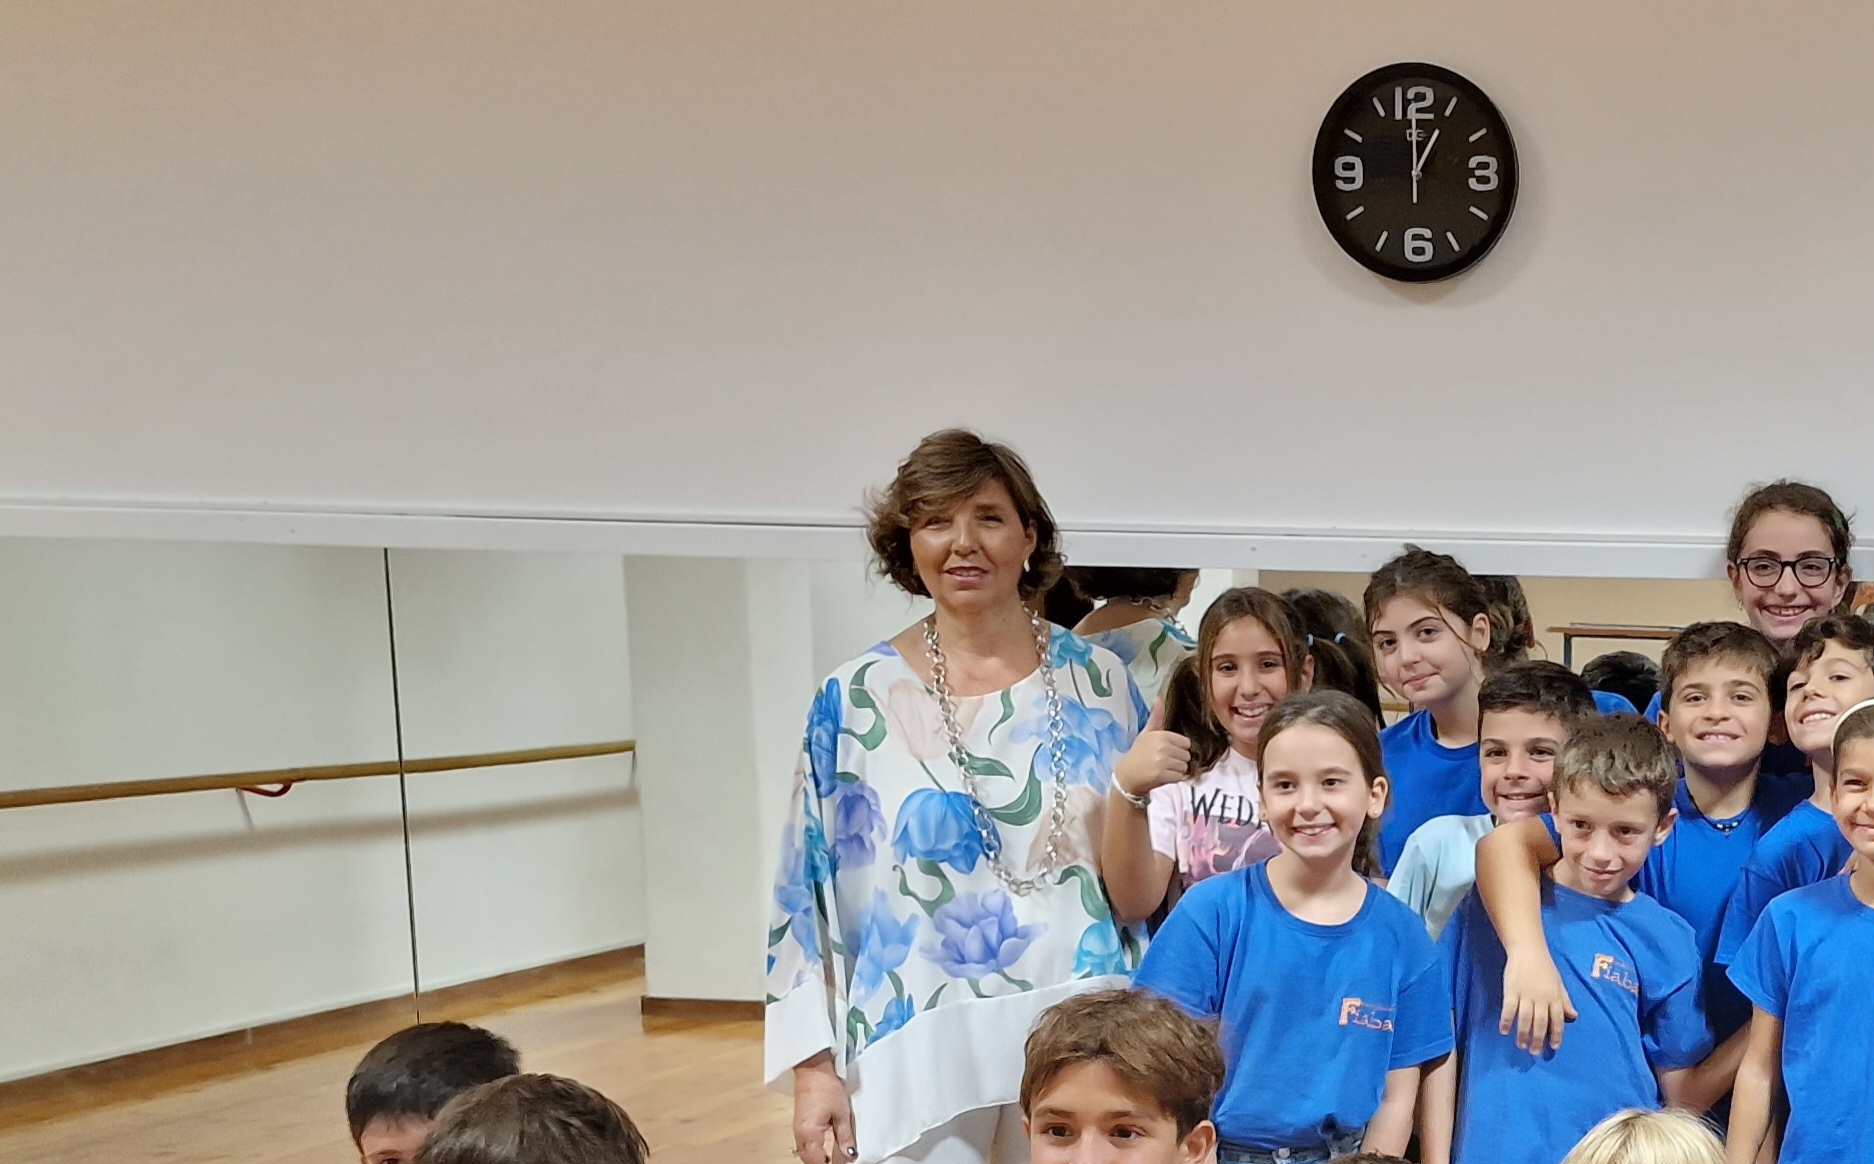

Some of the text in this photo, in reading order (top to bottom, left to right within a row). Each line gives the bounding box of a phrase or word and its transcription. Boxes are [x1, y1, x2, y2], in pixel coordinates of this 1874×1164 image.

[1395, 86, 1434, 120] 12
[1334, 156, 1364, 191] 9
[1468, 155, 1499, 191] 3
[1404, 227, 1434, 263] 6
[1190, 785, 1262, 830] WED
